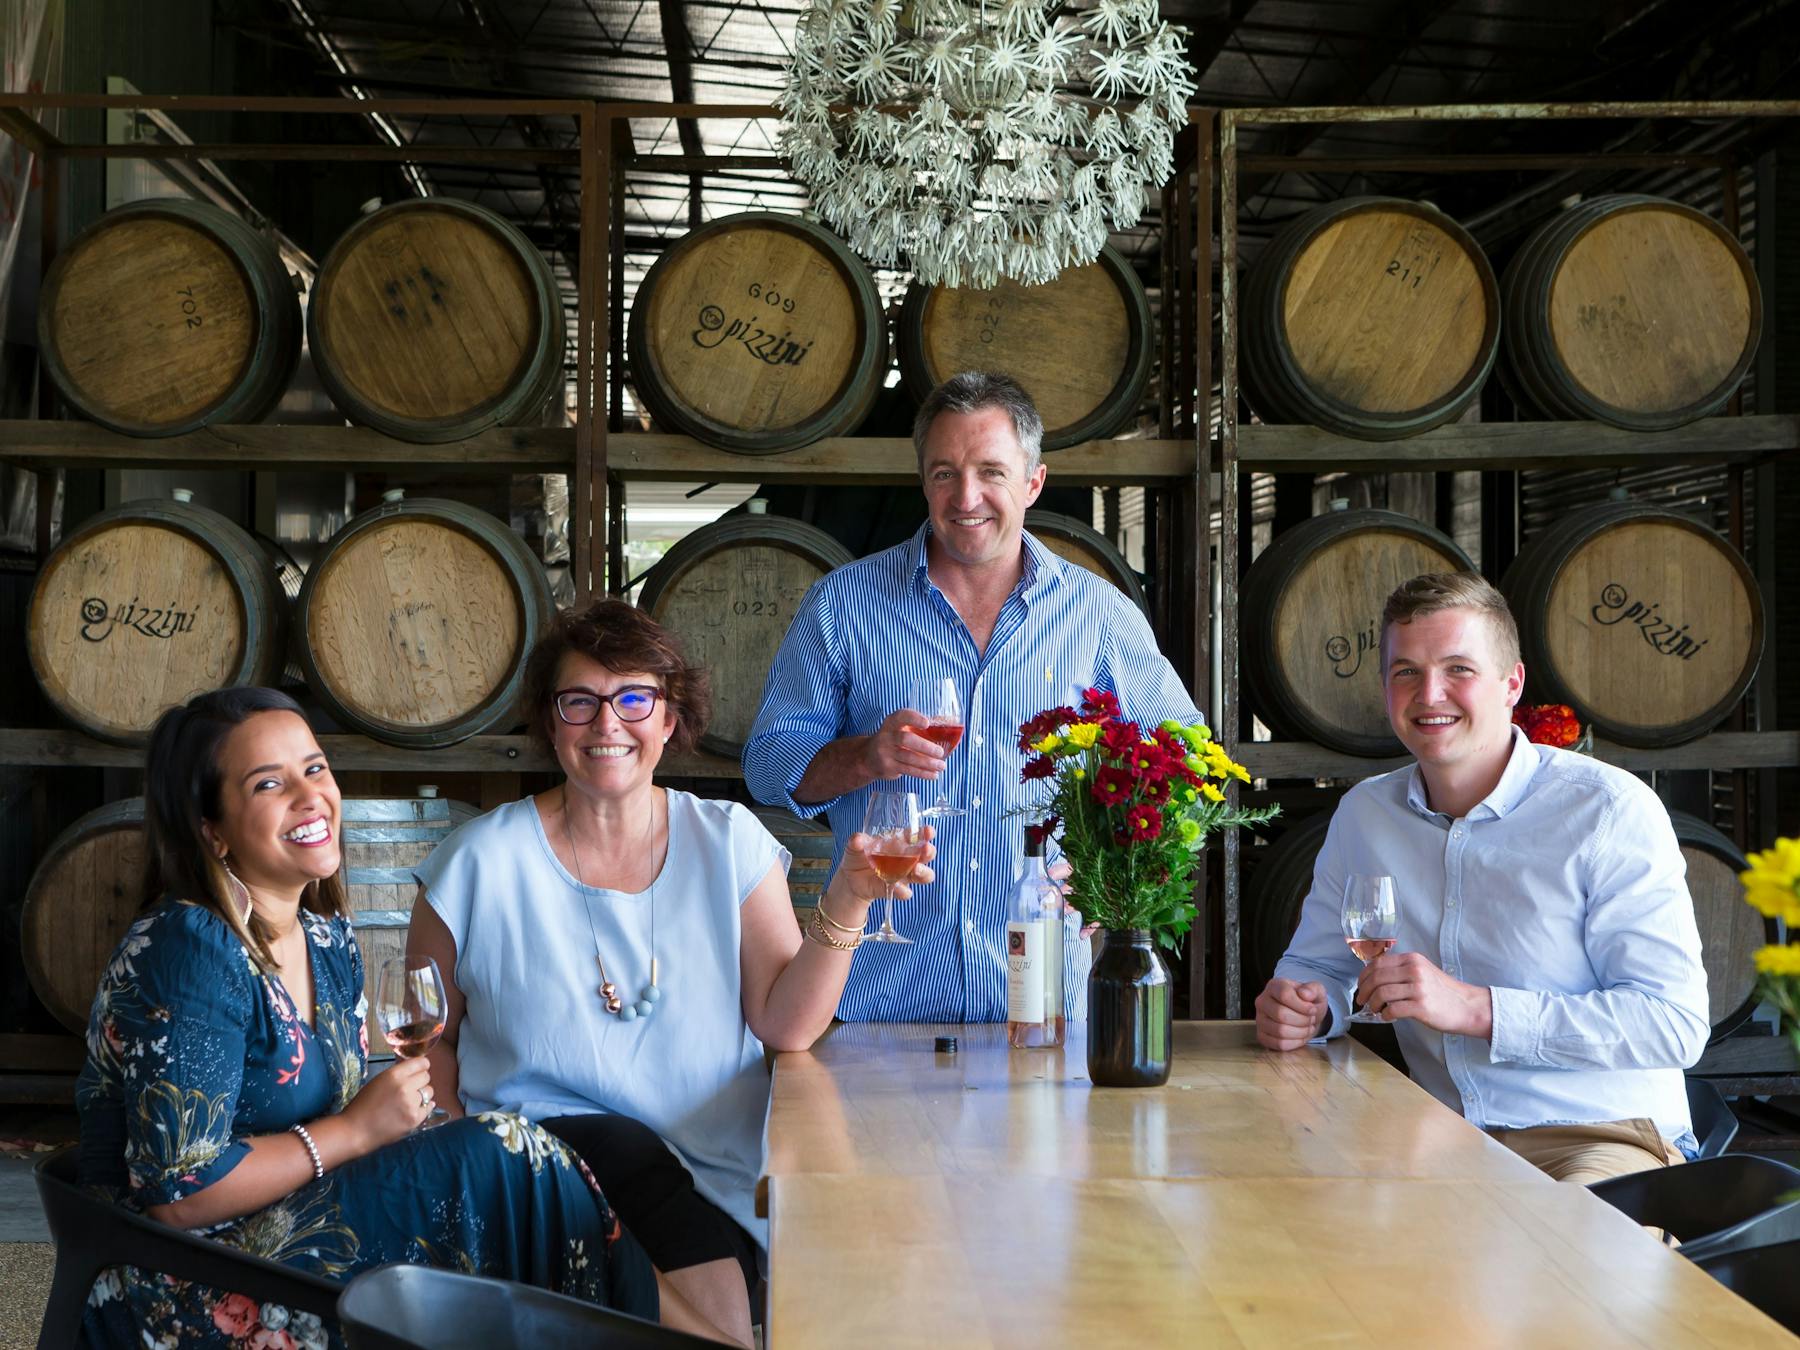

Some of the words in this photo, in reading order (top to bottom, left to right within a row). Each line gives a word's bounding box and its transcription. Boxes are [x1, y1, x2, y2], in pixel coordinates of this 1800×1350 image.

[1385, 260, 1421, 289] 211
[176, 285, 203, 329] 702
[748, 283, 796, 313] 609
[733, 601, 778, 617] 023
